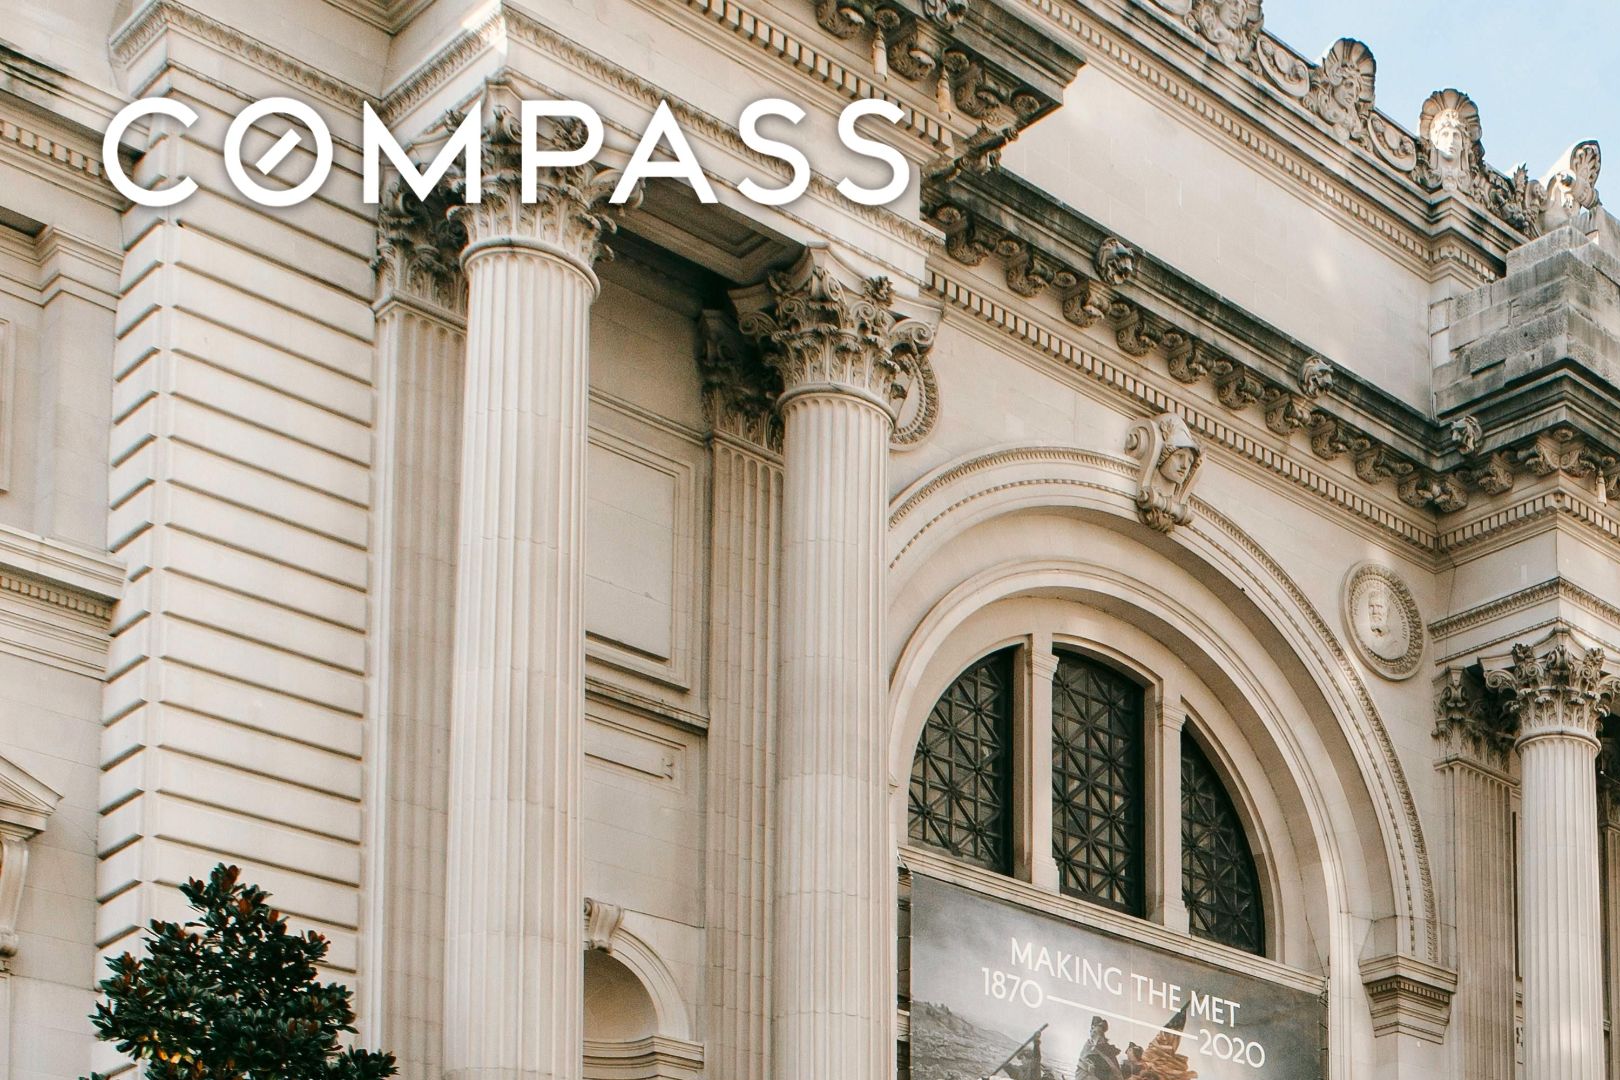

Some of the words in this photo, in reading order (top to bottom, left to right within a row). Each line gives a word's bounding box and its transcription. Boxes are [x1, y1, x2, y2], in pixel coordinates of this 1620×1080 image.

[981, 967, 1043, 1009] 1870
[1199, 1028, 1266, 1069] 2020
[1011, 937, 1122, 996] MAKING
[1131, 972, 1182, 1013] THE
[1190, 990, 1241, 1028] MET
